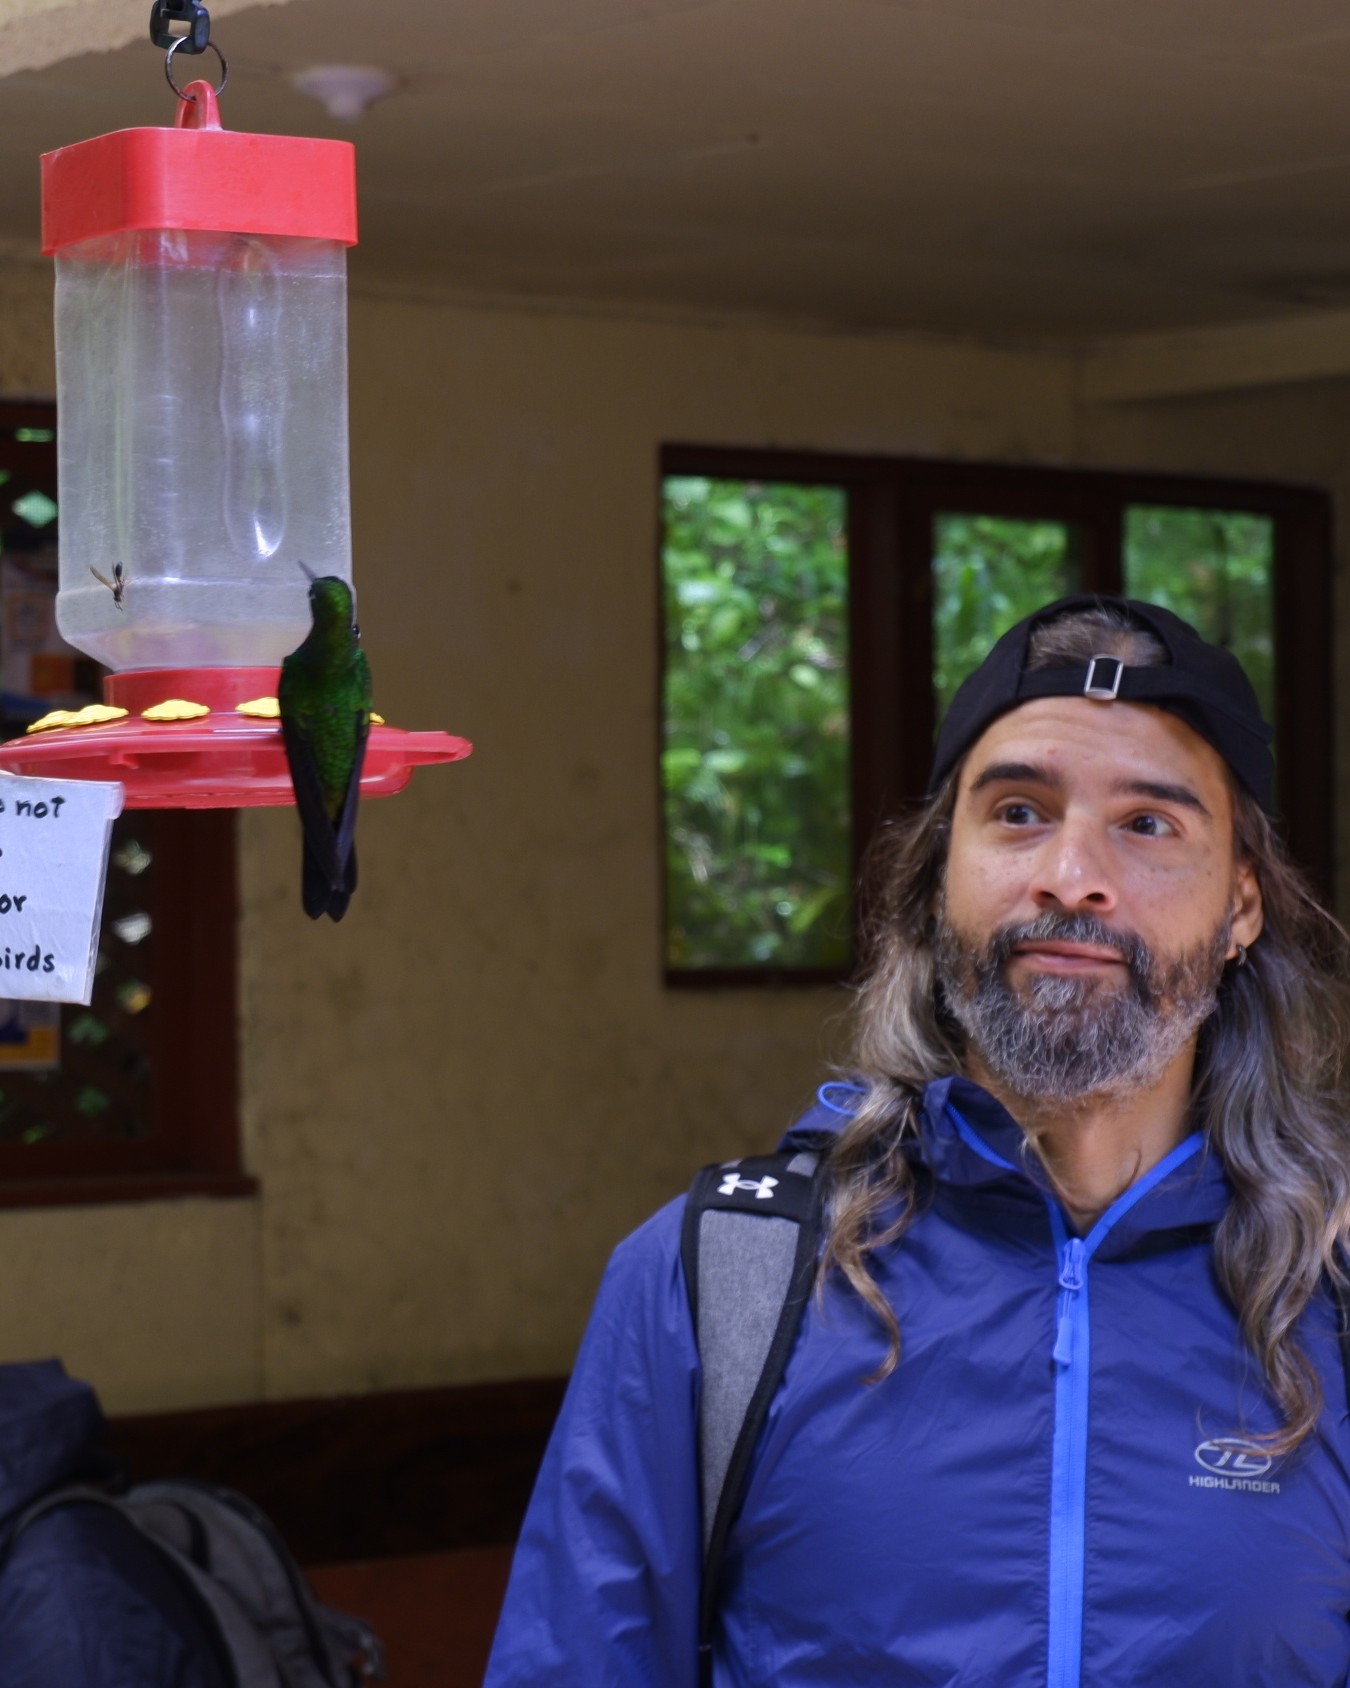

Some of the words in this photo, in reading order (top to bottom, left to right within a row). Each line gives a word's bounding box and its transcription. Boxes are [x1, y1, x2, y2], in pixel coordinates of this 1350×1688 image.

[16, 796, 65, 818] not
[0, 944, 55, 973] irds
[1188, 1475, 1281, 1494] HIGHLANDER
